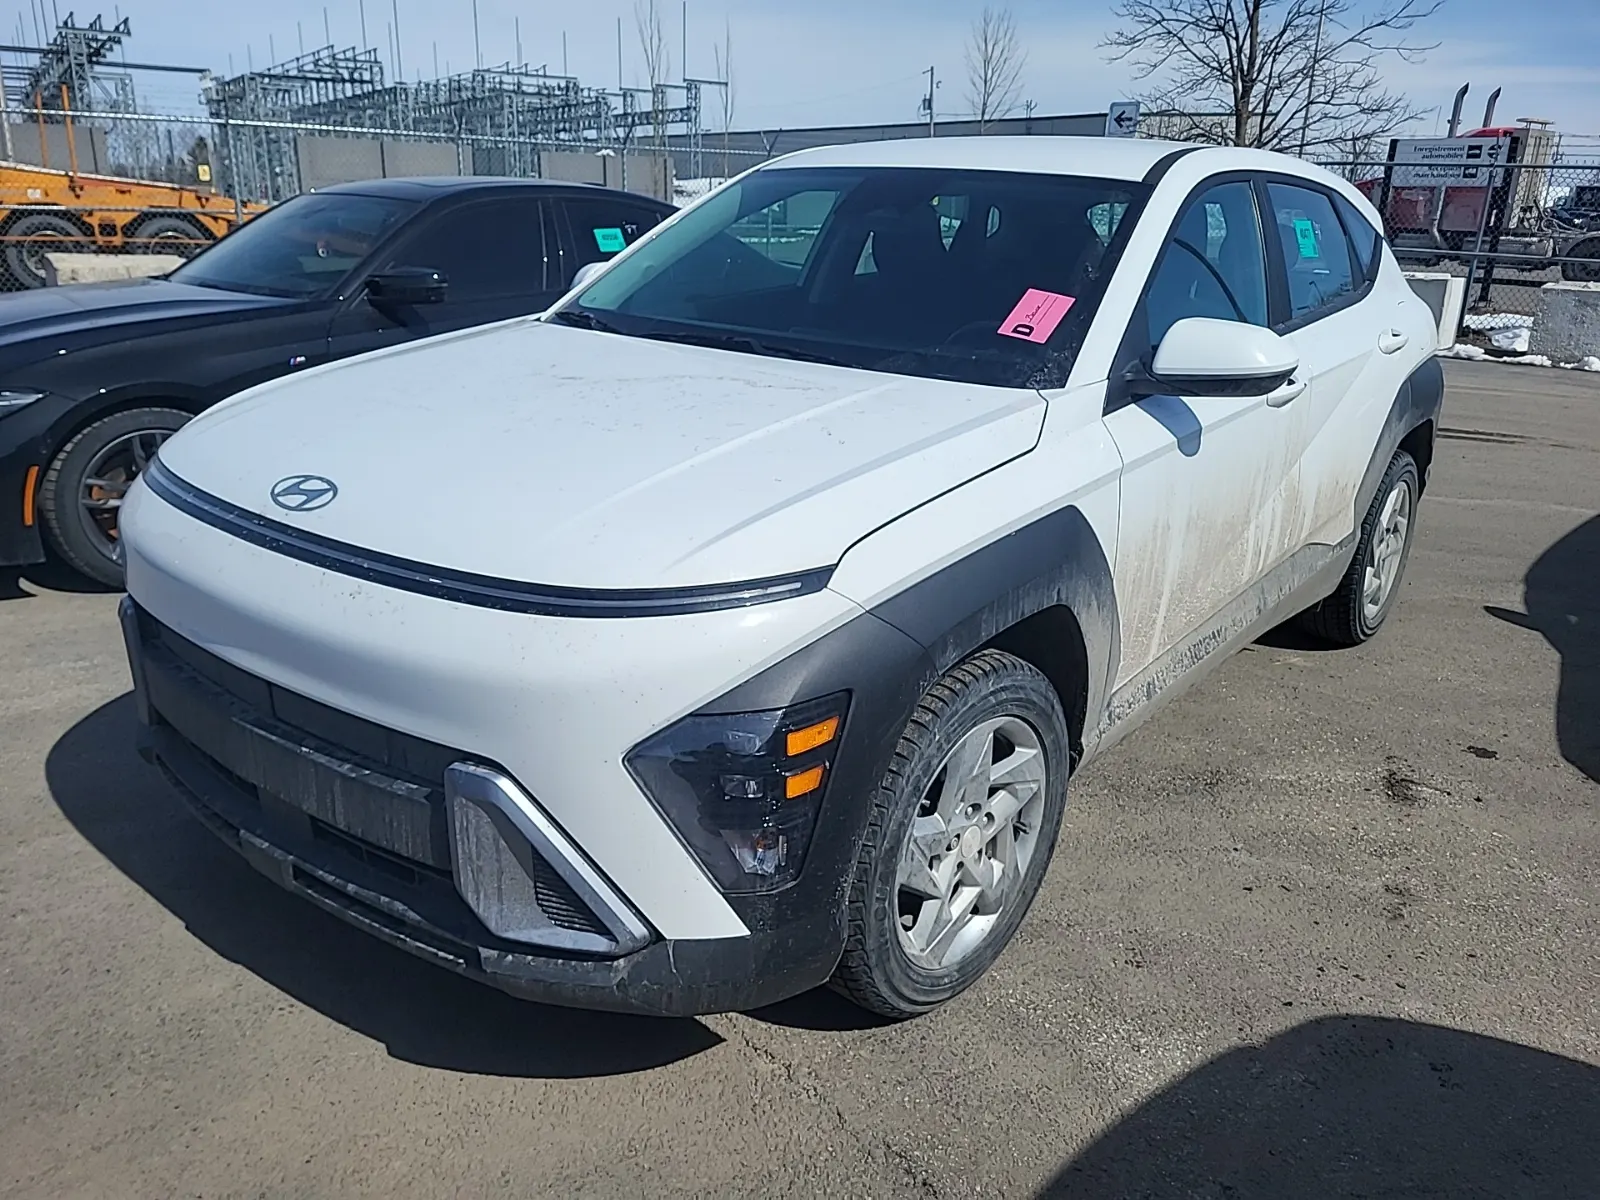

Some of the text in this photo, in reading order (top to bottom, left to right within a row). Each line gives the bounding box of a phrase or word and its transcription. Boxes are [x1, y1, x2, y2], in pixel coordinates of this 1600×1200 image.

[1413, 145, 1465, 154] Enregistrement
[1421, 151, 1463, 159] automobiles
[1011, 323, 1034, 337] D
